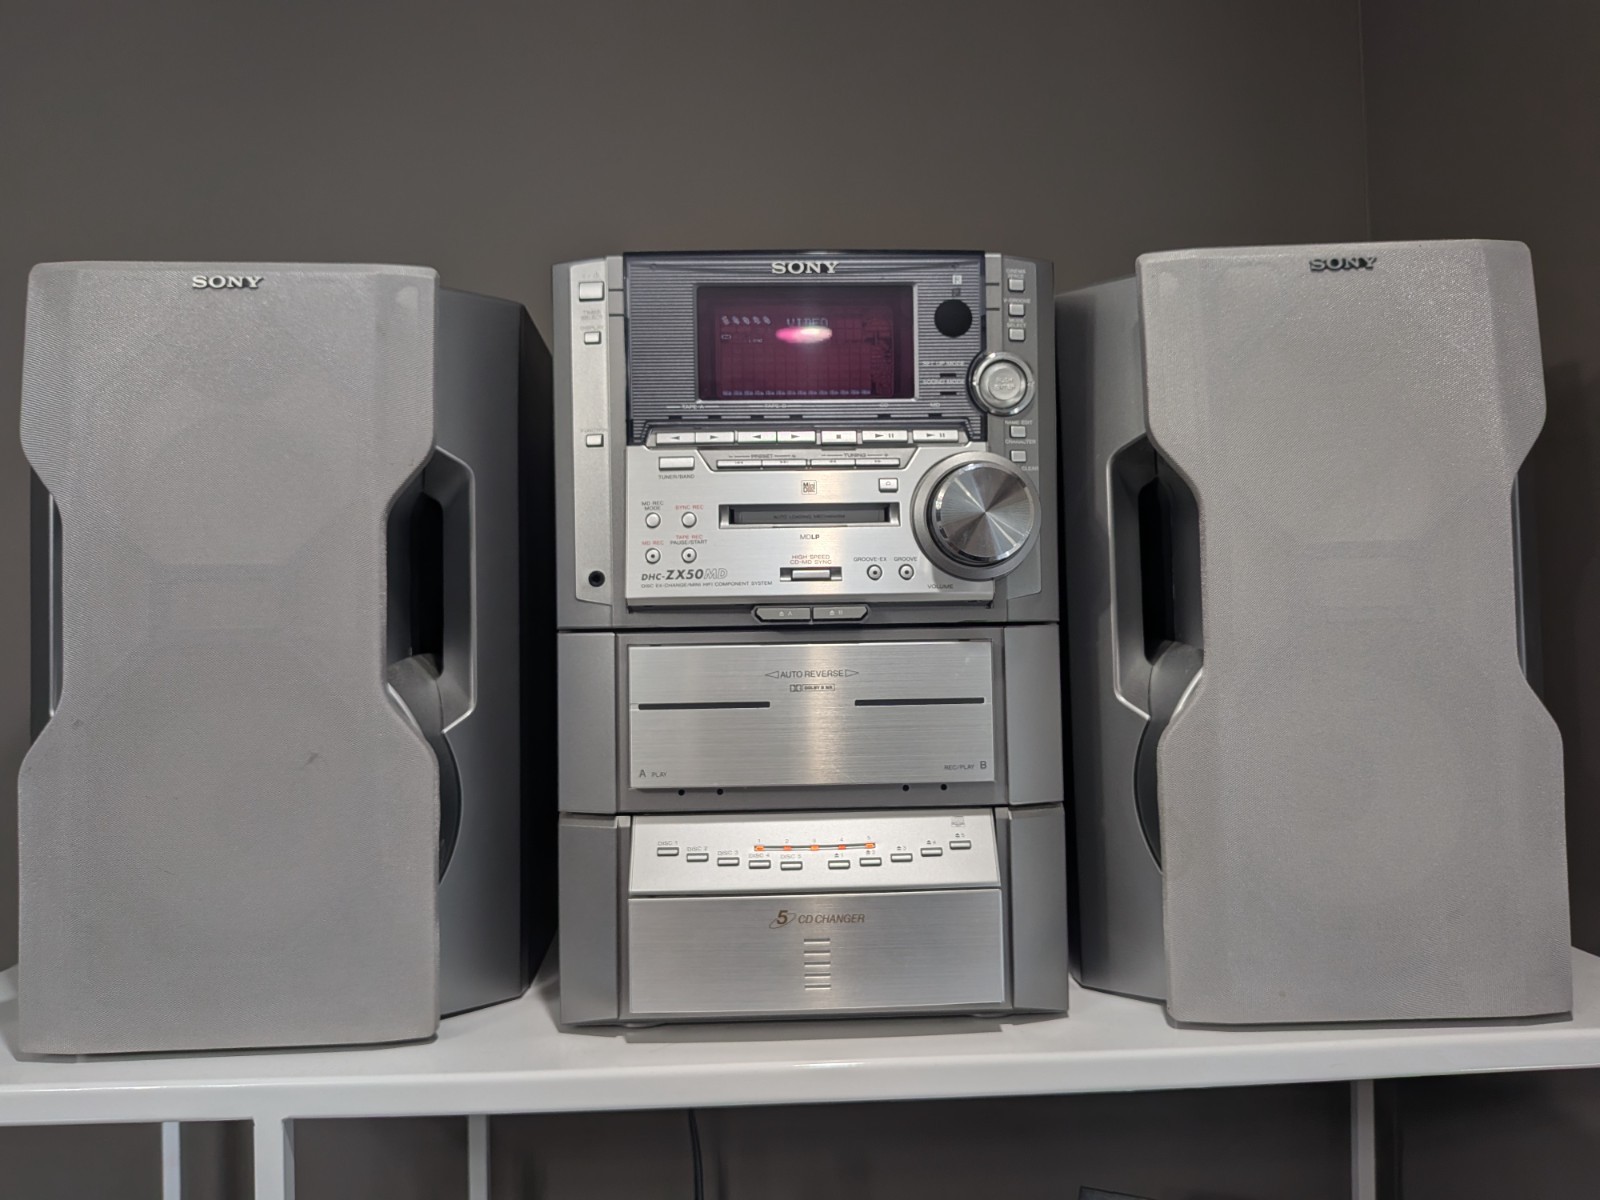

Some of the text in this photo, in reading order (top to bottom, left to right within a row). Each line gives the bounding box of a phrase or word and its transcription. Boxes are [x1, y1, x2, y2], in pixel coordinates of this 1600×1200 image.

[771, 260, 839, 274] SONY
[1309, 257, 1377, 272] SONY
[192, 275, 264, 289] SONY
[780, 669, 844, 678] AUTO REVERSE
[980, 761, 987, 769] B
[639, 769, 646, 778] A
[777, 910, 865, 925] 5 CD CHANGER
